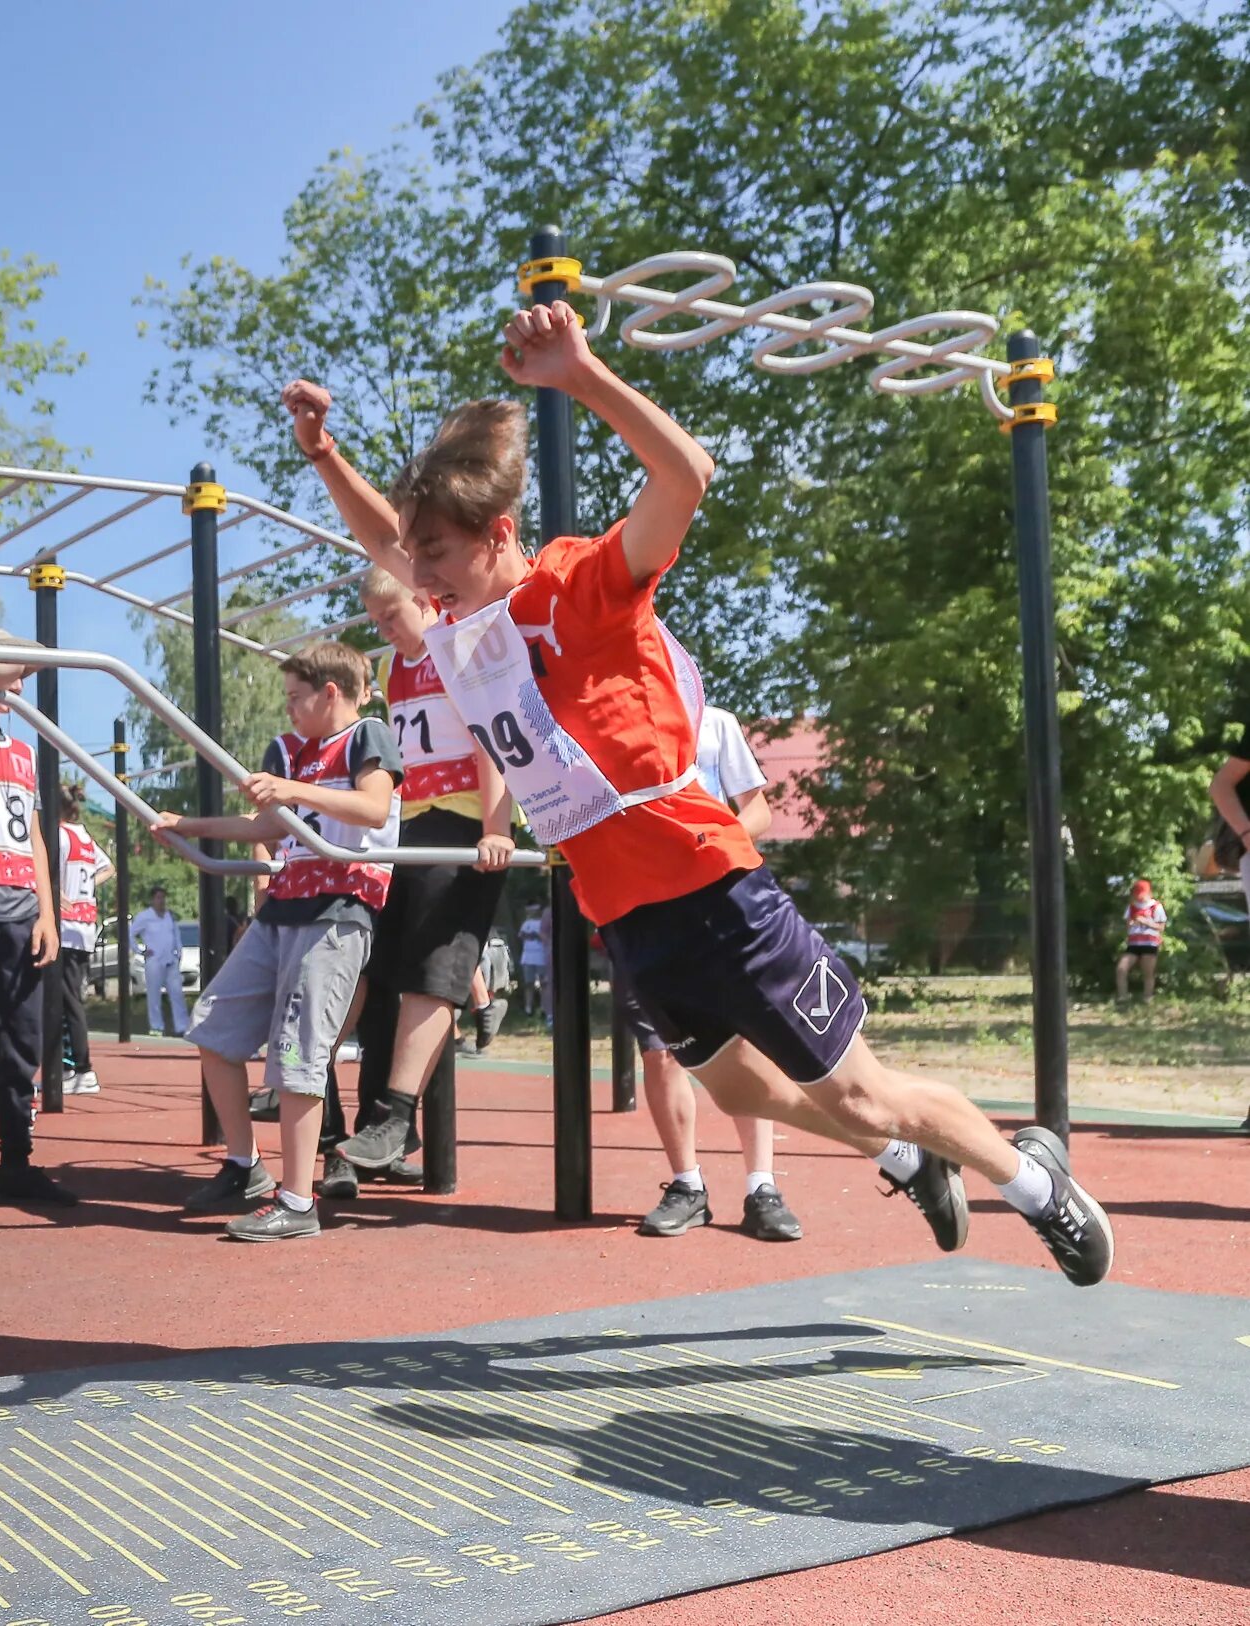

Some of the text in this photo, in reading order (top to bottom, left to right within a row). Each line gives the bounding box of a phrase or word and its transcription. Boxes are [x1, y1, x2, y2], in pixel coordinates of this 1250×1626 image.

[1008, 1437, 1066, 1454] 50
[815, 1478, 873, 1496] 90
[867, 1468, 925, 1485] 80
[703, 1498, 779, 1526] 110
[758, 1487, 834, 1513] 100
[585, 1520, 663, 1550] 130
[646, 1508, 723, 1537] 120
[458, 1544, 535, 1575] 150
[522, 1533, 600, 1562] 140
[320, 1567, 398, 1601] 170
[390, 1556, 468, 1588] 160
[247, 1580, 322, 1616] 180
